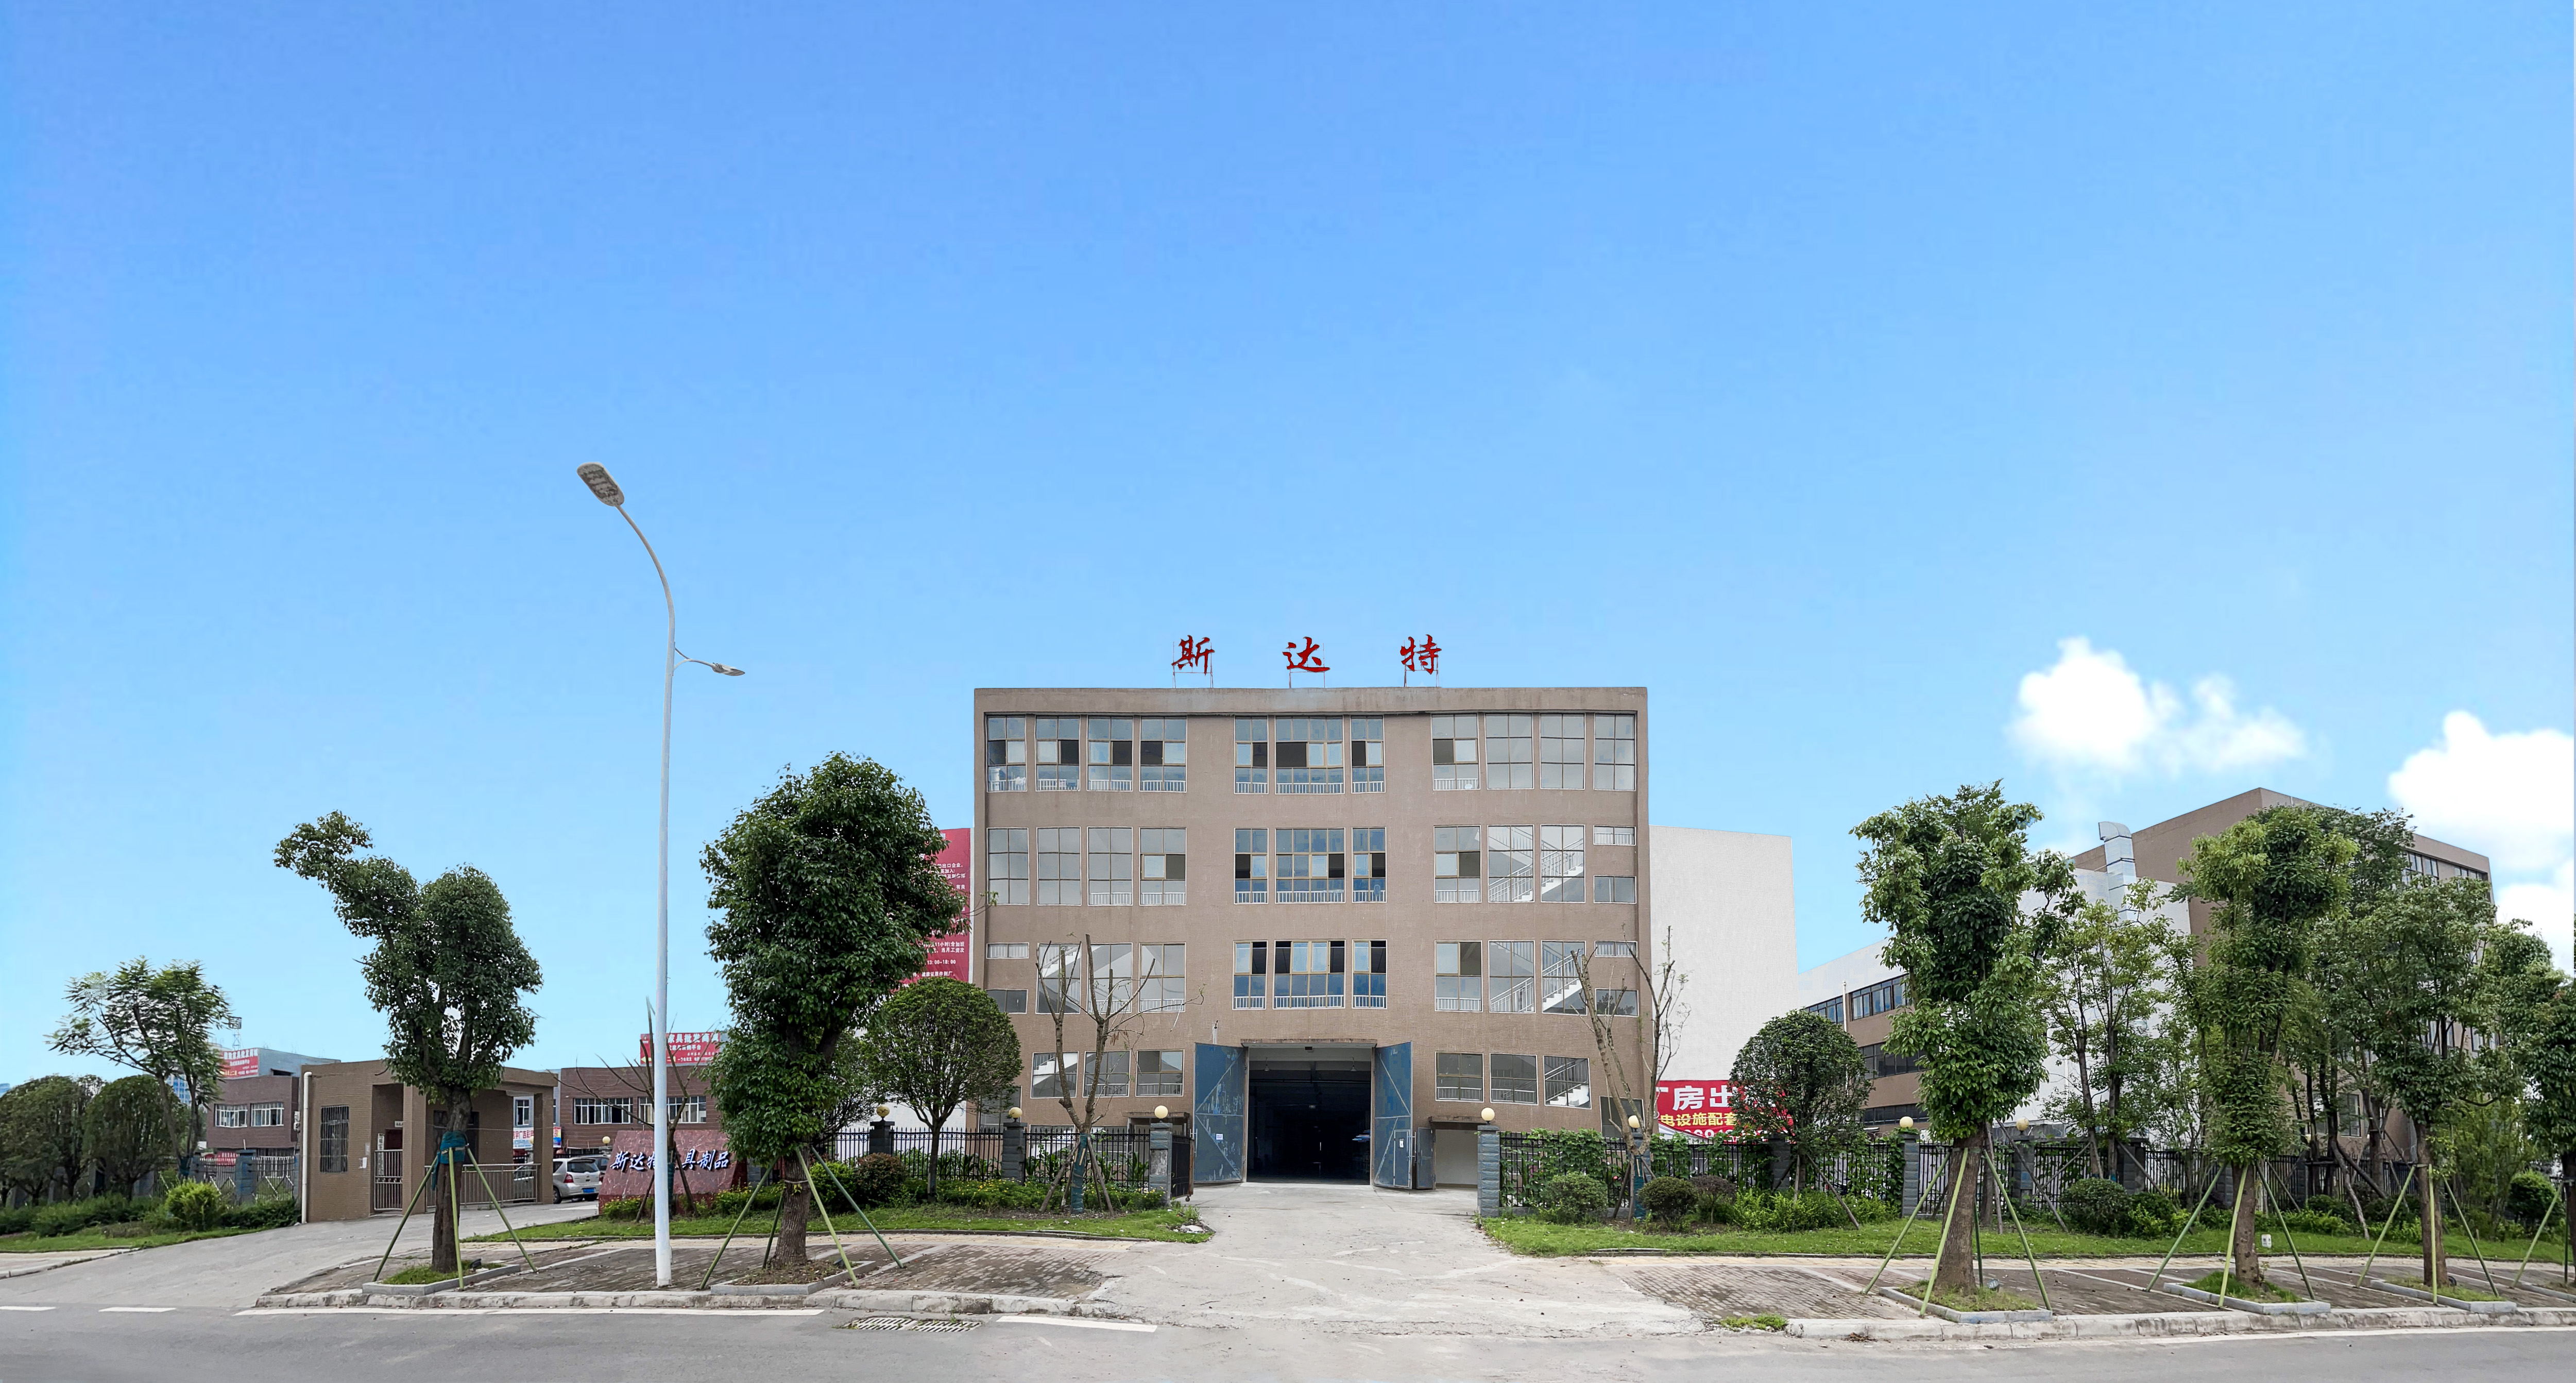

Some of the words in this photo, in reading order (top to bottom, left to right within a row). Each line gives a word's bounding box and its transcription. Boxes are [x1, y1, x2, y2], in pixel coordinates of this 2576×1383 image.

[1171, 634, 1442, 675] 斯达特
[1660, 1112, 1737, 1127] 电设施配套
[610, 1148, 729, 1171] 斯达具制品
